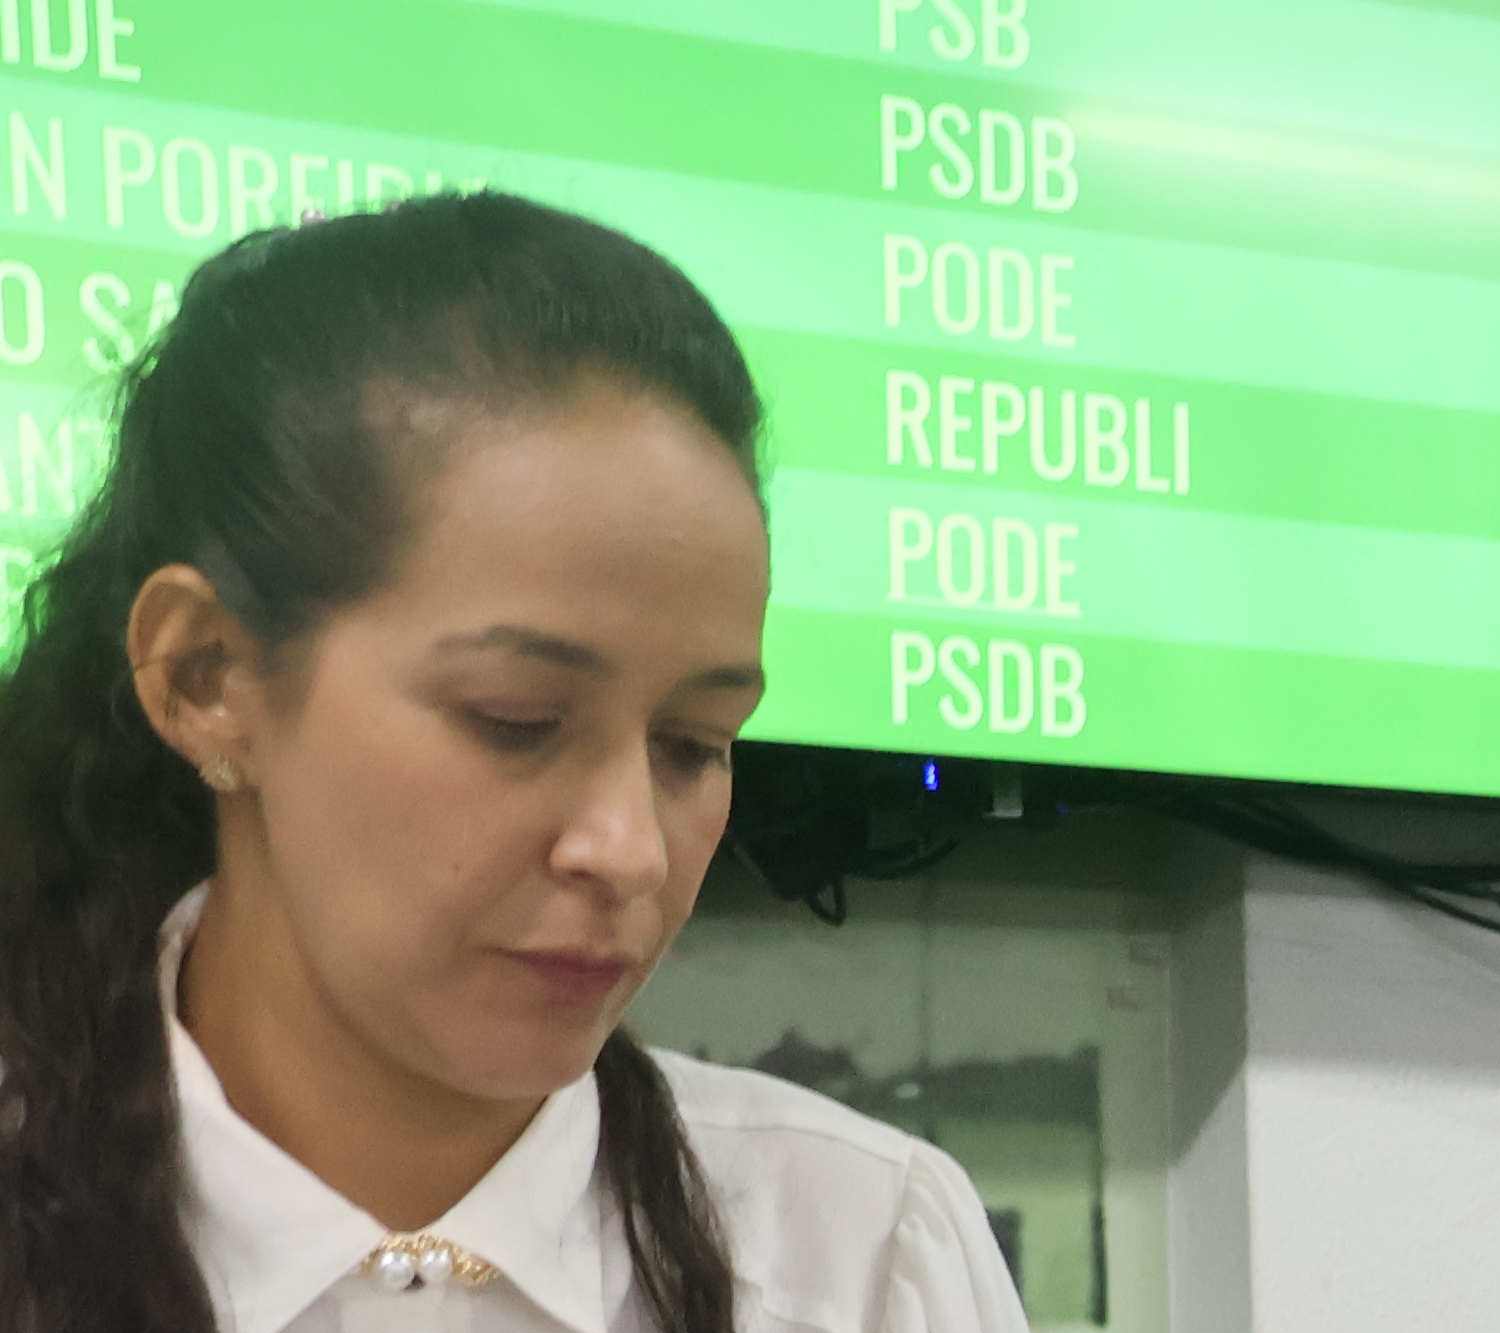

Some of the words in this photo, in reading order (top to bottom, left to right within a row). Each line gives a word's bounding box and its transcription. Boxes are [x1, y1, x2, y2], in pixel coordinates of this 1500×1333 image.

[879, 0, 1030, 69] PSB
[880, 94, 1078, 214] PSDB
[883, 233, 1076, 348] PODE
[886, 368, 1190, 496] REPUBLI
[888, 506, 1082, 618] PODE
[890, 629, 1087, 738] PSDB
